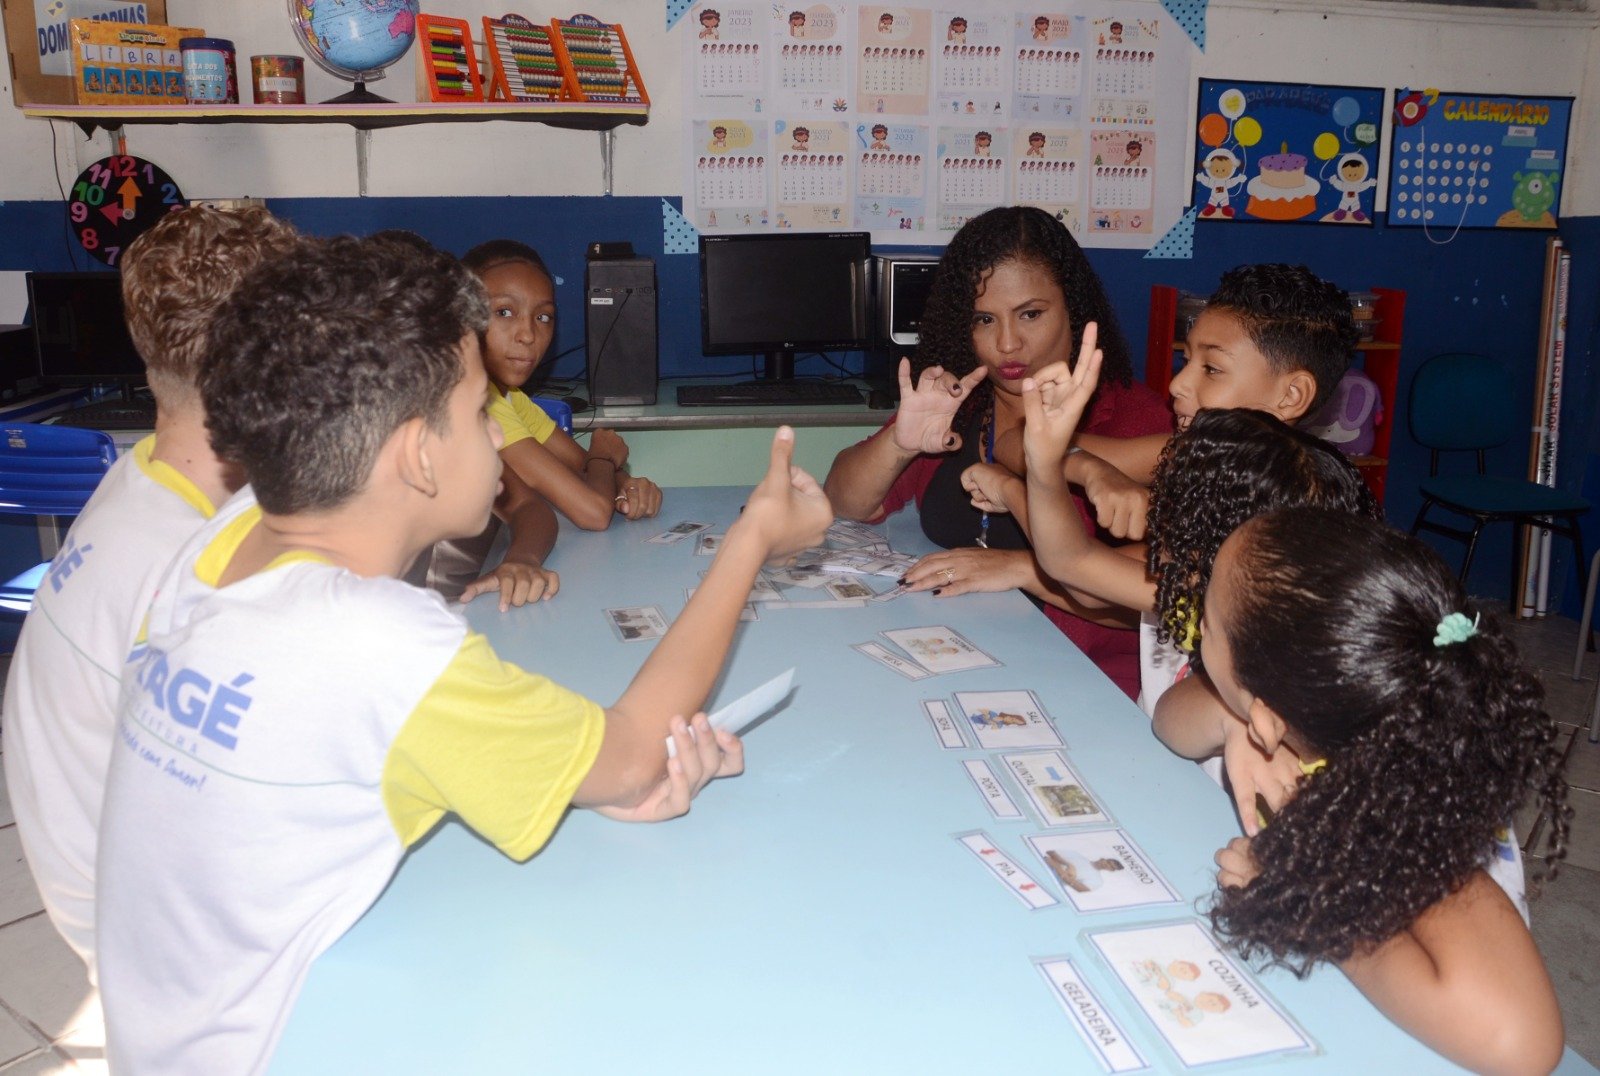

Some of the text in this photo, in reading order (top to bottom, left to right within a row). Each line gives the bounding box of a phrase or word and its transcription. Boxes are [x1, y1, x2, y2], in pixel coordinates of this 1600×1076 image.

[728, 18, 752, 26] 2023
[811, 20, 834, 28] 2023
[1443, 99, 1550, 126] CALENDÁRIO
[89, 163, 112, 190] 11
[108, 154, 138, 178] 12
[142, 163, 155, 185] 1
[74, 181, 104, 206] 10
[161, 182, 179, 204] 2
[70, 201, 88, 223] 9
[81, 228, 99, 250] 8
[104, 246, 120, 266] 7
[1551, 340, 1563, 389] SYSTEM
[1011, 759, 1037, 787] QUINTAL
[979, 776, 1001, 800] PORTA
[996, 861, 1016, 878] PIA
[1112, 844, 1155, 886] BANHEIRO
[1207, 958, 1259, 1010] COZINHA
[1062, 981, 1117, 1048] GELADEIRA
